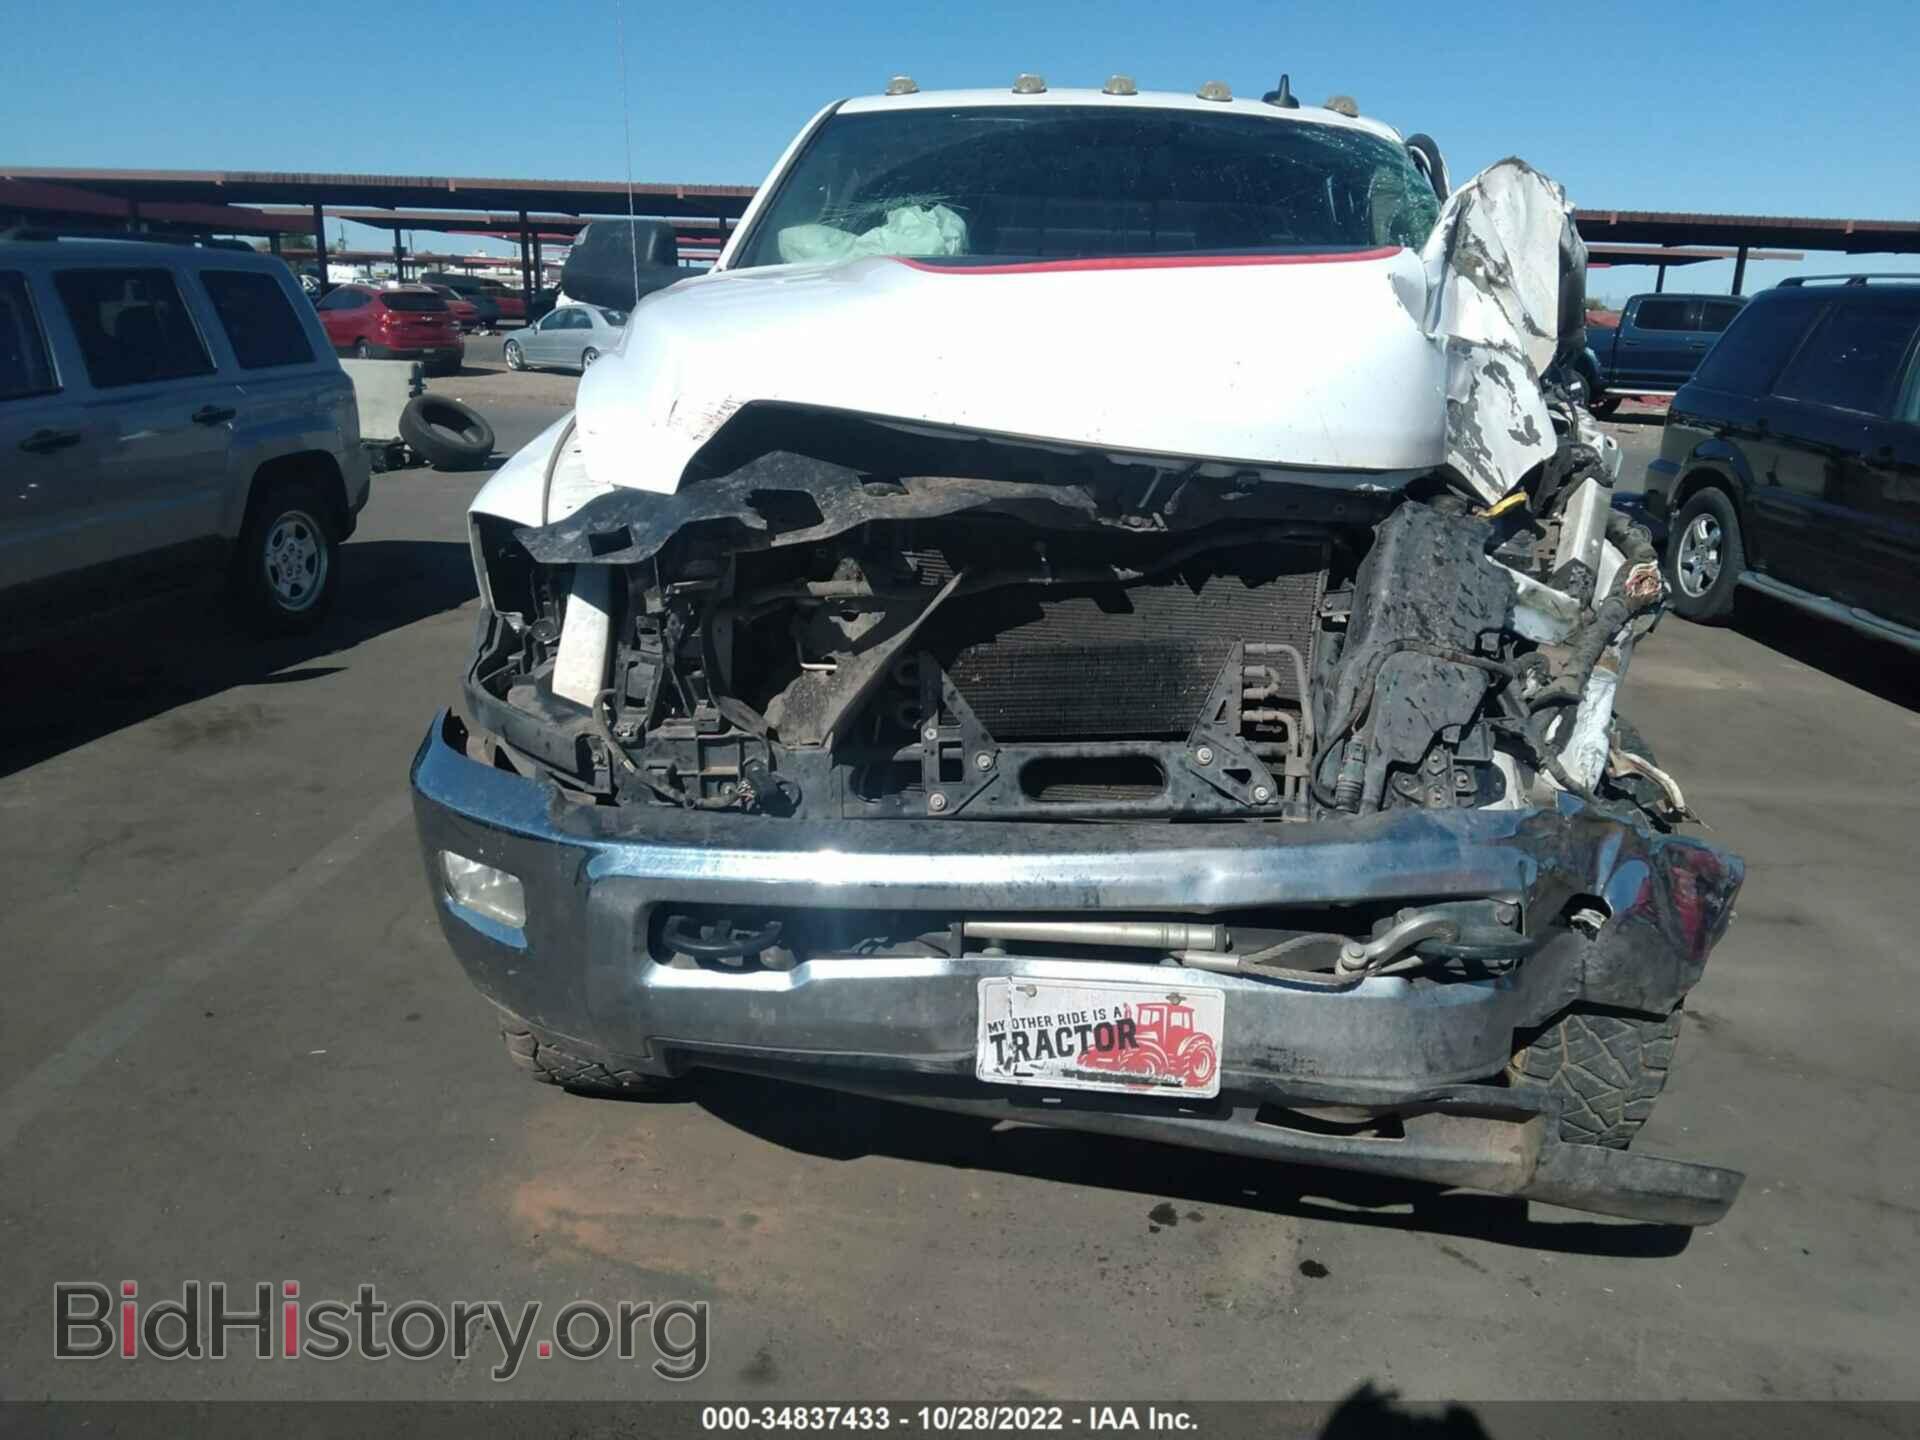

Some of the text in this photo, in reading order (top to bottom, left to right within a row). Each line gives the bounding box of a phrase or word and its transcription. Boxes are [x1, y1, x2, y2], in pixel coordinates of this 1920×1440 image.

[987, 1006, 1123, 1034] MY OTHER RIDE IS A
[989, 1018, 1140, 1066] TRACTOR
